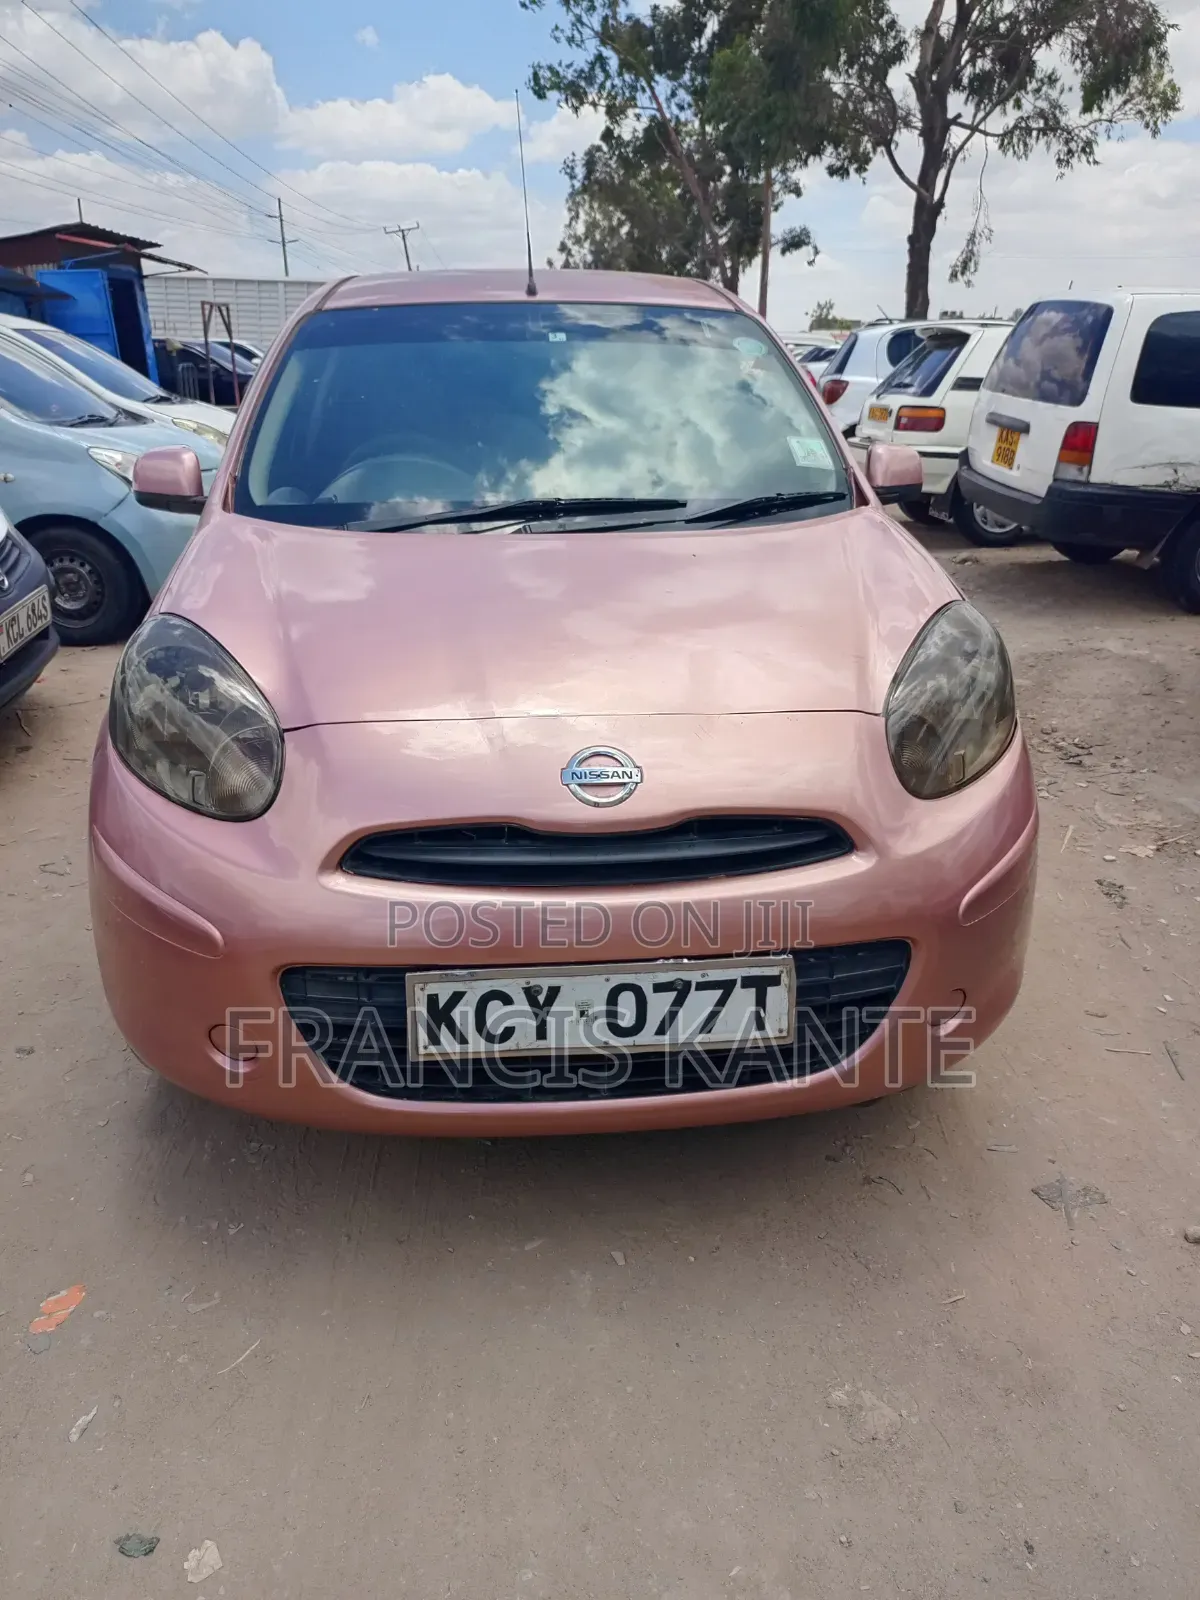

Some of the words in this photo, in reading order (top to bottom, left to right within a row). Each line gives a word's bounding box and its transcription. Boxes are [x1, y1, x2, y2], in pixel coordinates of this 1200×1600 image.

[5, 613, 24, 650] KCL
[27, 594, 48, 632] 684S
[571, 770, 633, 780] NISSAN
[424, 985, 562, 1047] KCY
[606, 974, 782, 1038] 077T
